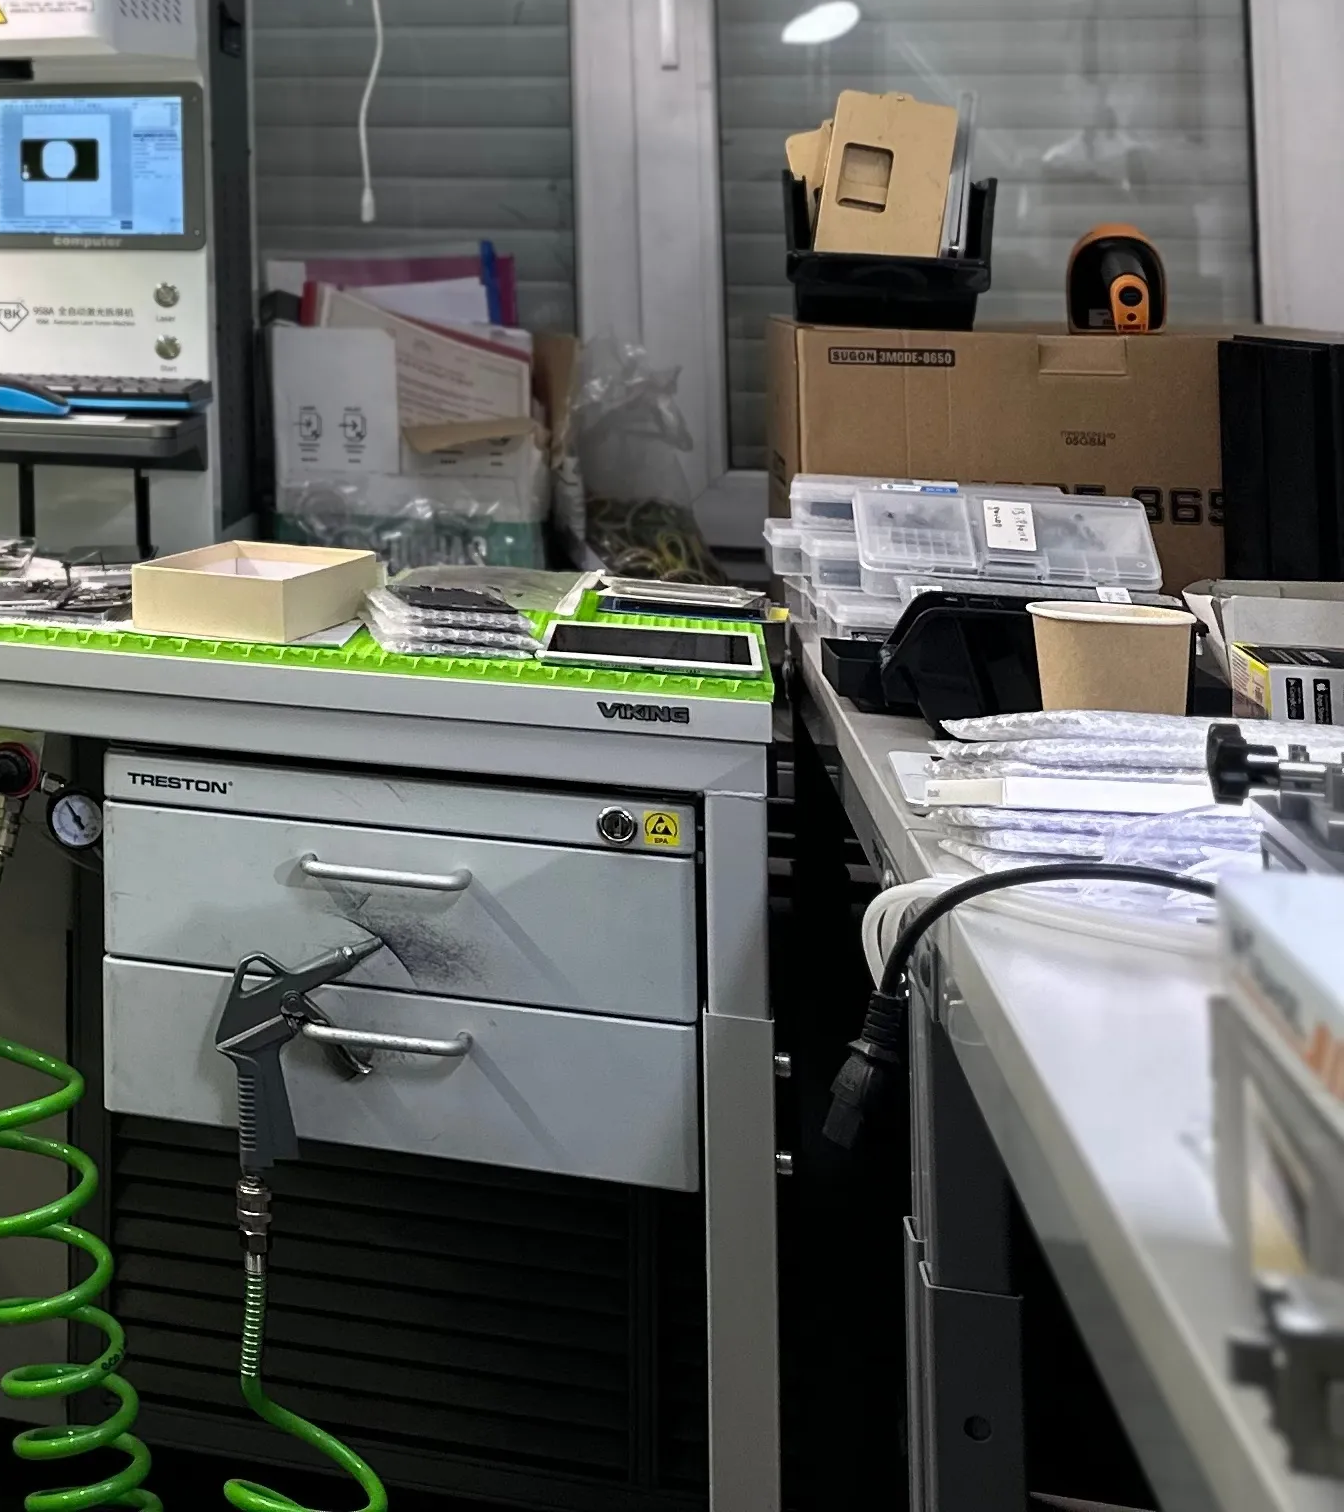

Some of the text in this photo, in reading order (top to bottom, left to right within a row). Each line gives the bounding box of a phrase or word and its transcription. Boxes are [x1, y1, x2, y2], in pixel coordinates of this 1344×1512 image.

[52, 236, 123, 249] computer
[832, 351, 875, 363] SUGON
[596, 700, 691, 725] VIKING
[127, 771, 228, 795] TRESTON
[654, 837, 669, 845] EPA
